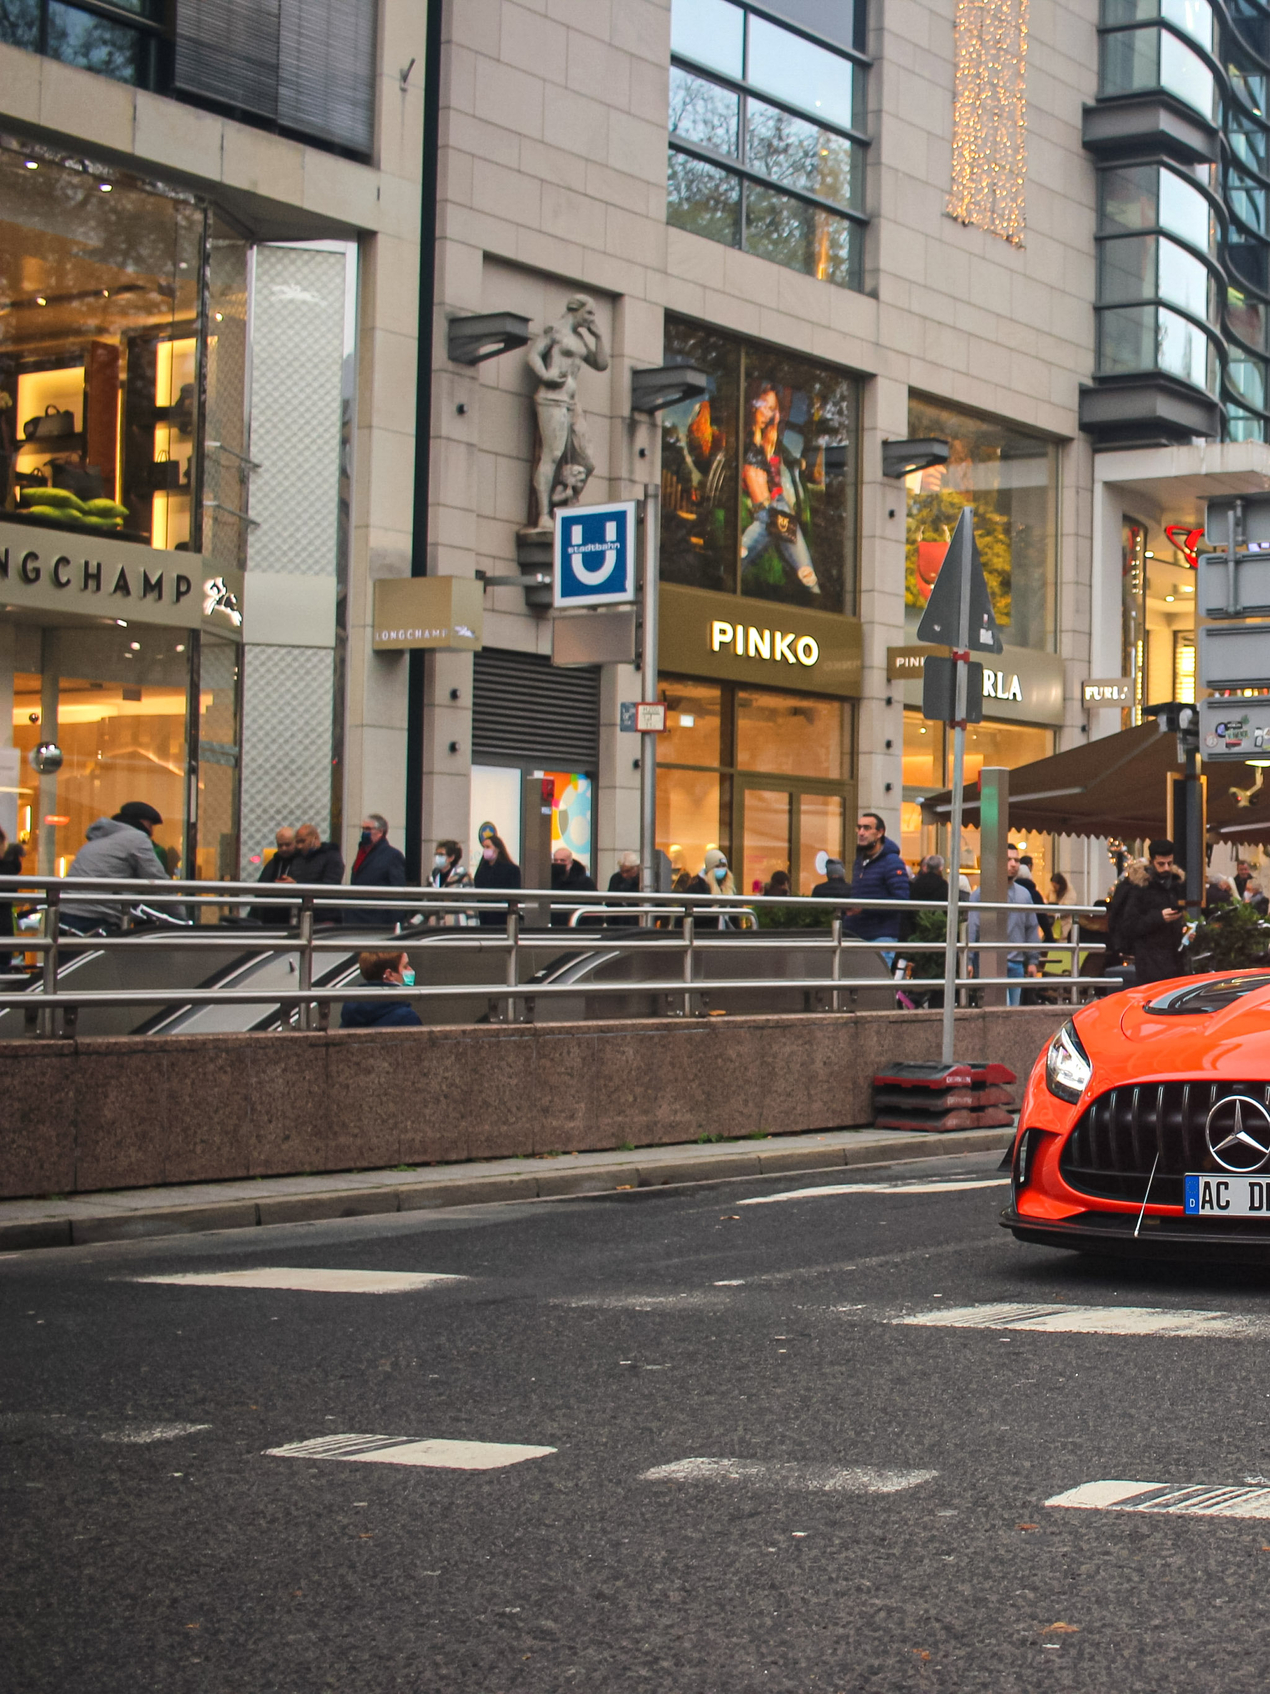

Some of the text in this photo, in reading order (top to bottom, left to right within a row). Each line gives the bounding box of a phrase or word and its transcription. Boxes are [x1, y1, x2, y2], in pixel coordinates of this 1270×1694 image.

[568, 542, 620, 554] stadtbahn
[375, 628, 448, 641] LONGCHAMP
[711, 620, 819, 666] PINKO
[1201, 1181, 1230, 1210] AC
[1190, 1199, 1195, 1207] D
